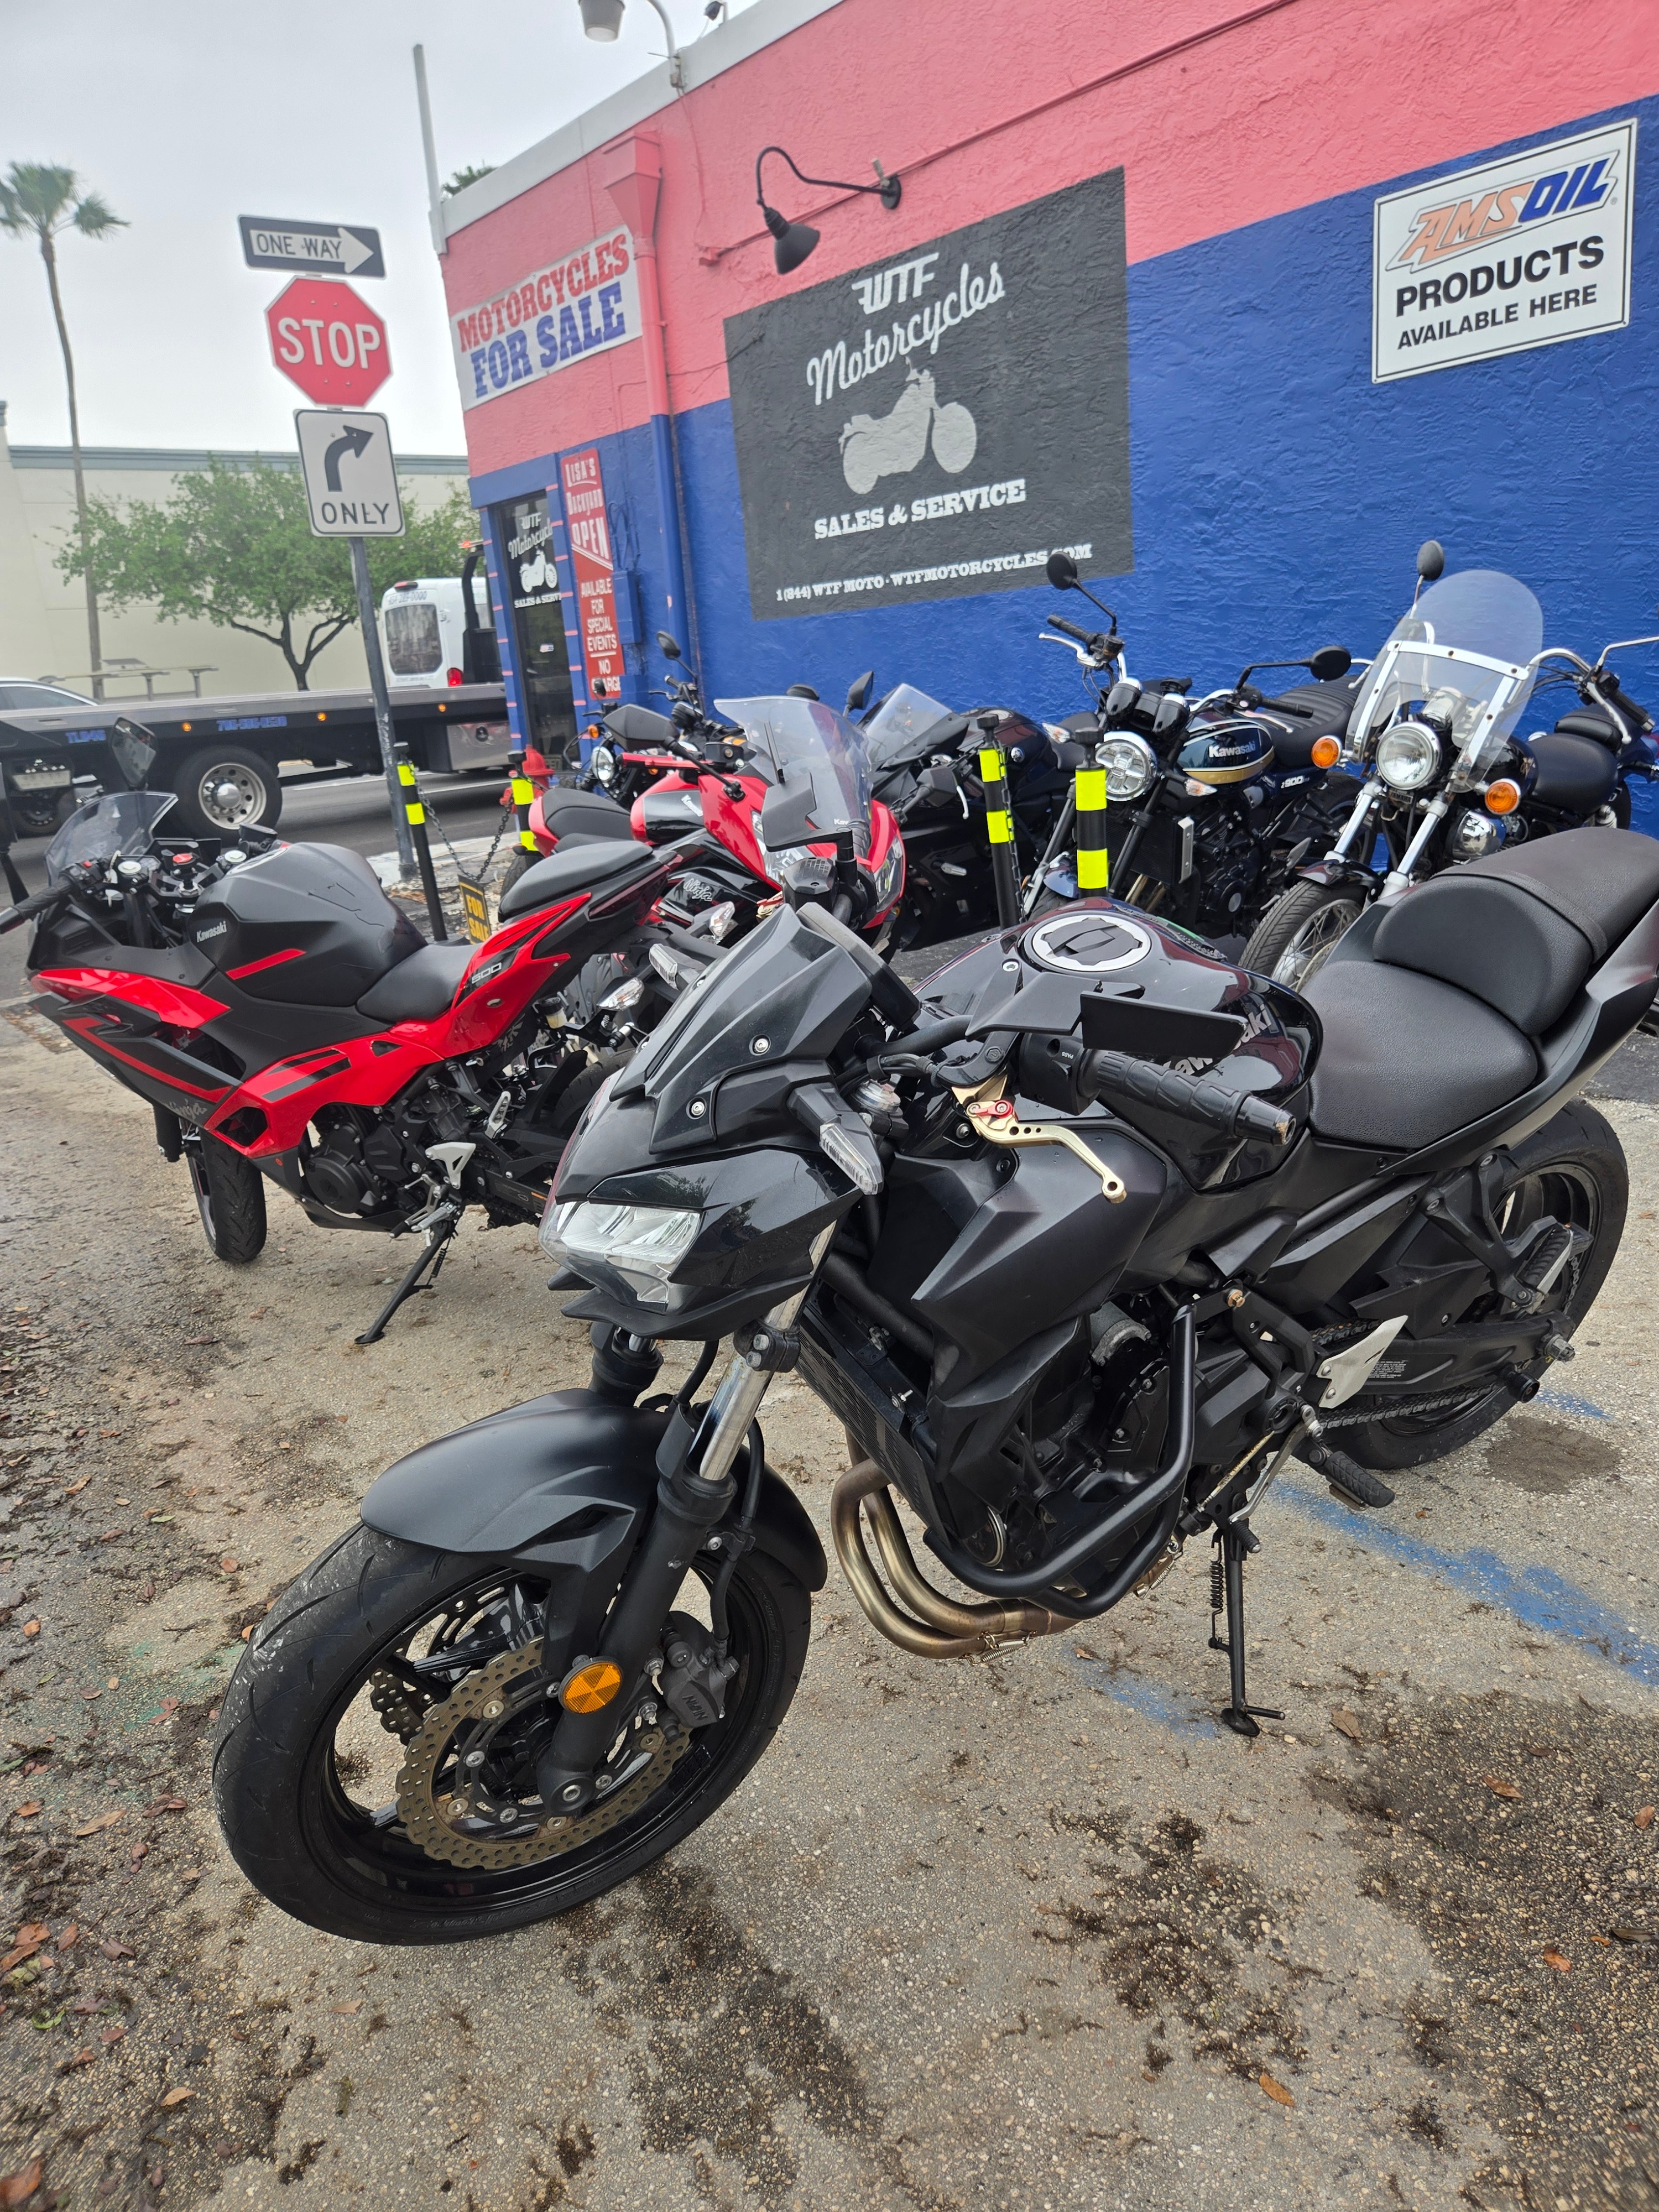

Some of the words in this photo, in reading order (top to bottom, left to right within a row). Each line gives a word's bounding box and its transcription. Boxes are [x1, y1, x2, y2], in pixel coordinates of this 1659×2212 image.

[256, 233, 297, 256] ONE
[304, 237, 342, 260] WAY
[851, 252, 940, 315] WTF
[1396, 236, 1604, 317] PRODUCTS
[457, 233, 629, 353] MOTORCYCLES
[1397, 302, 1519, 350] AVAILABLE
[1529, 284, 1598, 319] HERE
[277, 317, 381, 369] STOP
[470, 330, 533, 399] FOR
[536, 281, 626, 368] SALE
[806, 262, 1005, 405] Motorcycles
[321, 502, 390, 525] ONLY
[519, 512, 541, 530] WTF
[815, 507, 884, 540] SALES
[888, 504, 907, 526] &
[911, 478, 1026, 523] SERVICE
[571, 517, 609, 560] OPEN
[581, 578, 612, 597] AVAILABLE
[776, 591, 783, 601] 1
[784, 586, 811, 602] (844)
[812, 582, 843, 597] WTF
[843, 576, 884, 593] MOTO
[591, 598, 604, 615] FOR
[587, 617, 613, 634] SPECIAL
[587, 634, 617, 651] EVENTS
[598, 659, 611, 675] NO
[1209, 741, 1256, 758] Kawasaki
[683, 878, 713, 902] Ninja
[466, 894, 485, 921] FOR
[197, 920, 227, 943] Kawasaki
[472, 962, 502, 984] 500
